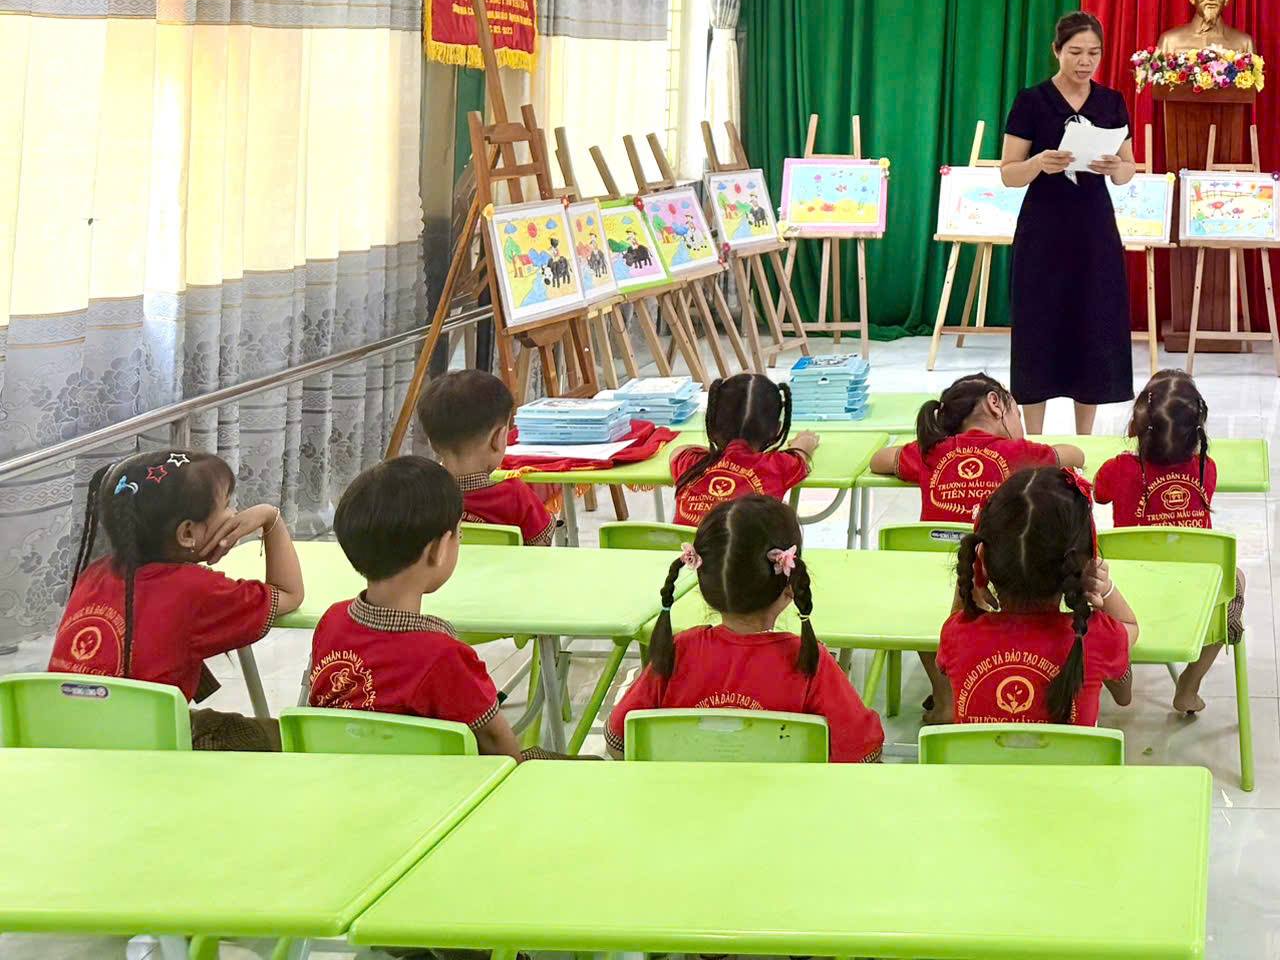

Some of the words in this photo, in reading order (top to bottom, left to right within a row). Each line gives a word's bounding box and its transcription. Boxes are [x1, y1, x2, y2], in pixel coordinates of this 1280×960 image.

[941, 488, 966, 500] TIÊN
[976, 658, 993, 674] DỤC
[991, 650, 1003, 666] VÀ
[1004, 648, 1021, 663] ĐÀO
[1022, 651, 1039, 666] TẠO
[720, 690, 735, 704] ĐÀO
